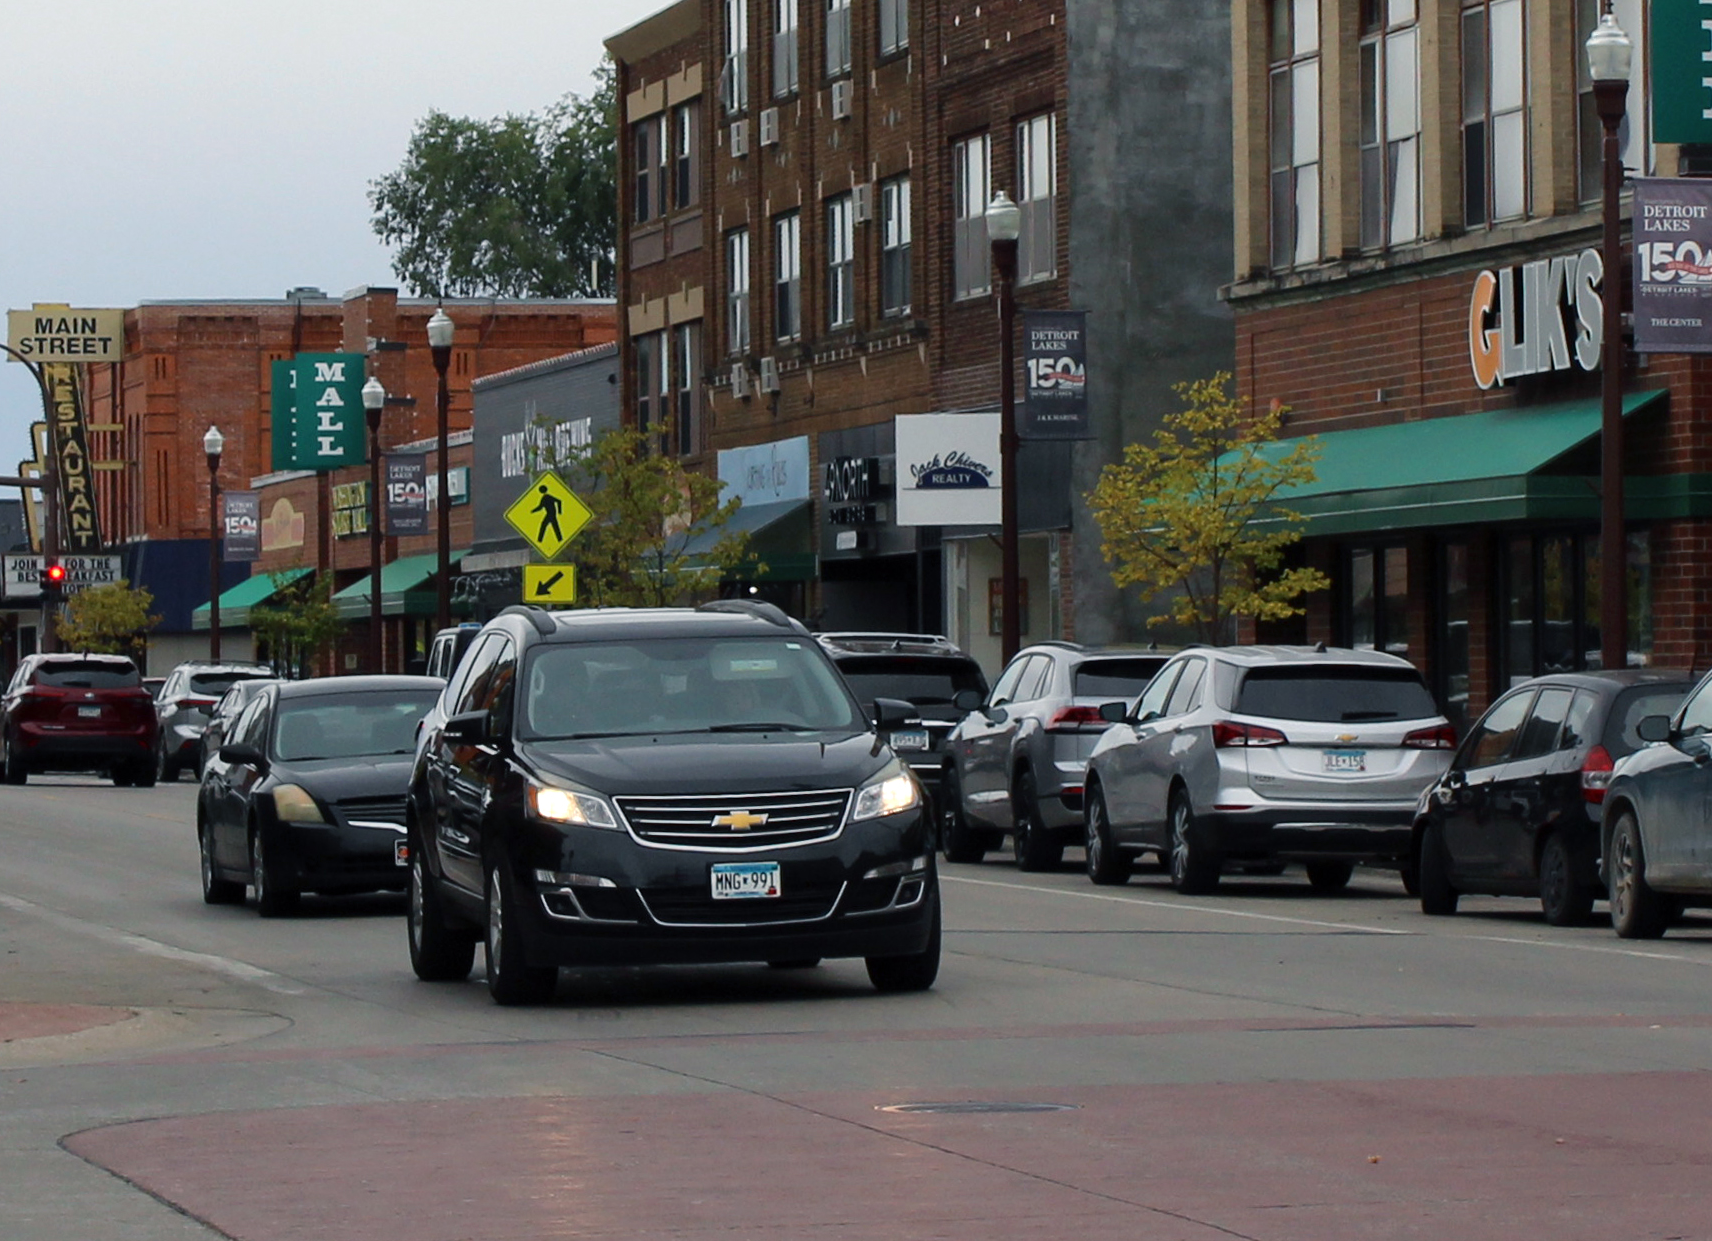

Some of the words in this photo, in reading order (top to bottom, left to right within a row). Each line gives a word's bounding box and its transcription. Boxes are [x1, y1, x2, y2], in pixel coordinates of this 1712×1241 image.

[1643, 205, 1708, 218] DETROIT
[1644, 219, 1691, 232] LAKES
[1638, 240, 1703, 284] 150
[35, 317, 97, 335] MAIN
[1469, 247, 1604, 390] GLIK'S
[1651, 318, 1668, 327] THE
[1669, 318, 1703, 328] CENTER
[1031, 331, 1079, 341] DETROIT
[19, 337, 113, 356] STREET
[1031, 341, 1067, 351] LAKES
[1027, 356, 1077, 389] 150
[314, 362, 346, 456] MALL
[52, 363, 94, 548] RESTAURANT
[910, 452, 940, 481] Jack
[943, 450, 993, 478] Chivers
[932, 472, 972, 484] REALTY
[387, 481, 420, 503] 150
[224, 516, 254, 534] 150
[11, 559, 37, 570] JOIN
[64, 558, 85, 570] FOR
[91, 558, 111, 569] THE
[17, 570, 38, 582] BES
[715, 872, 741, 890] MNG
[751, 871, 774, 889] 991
